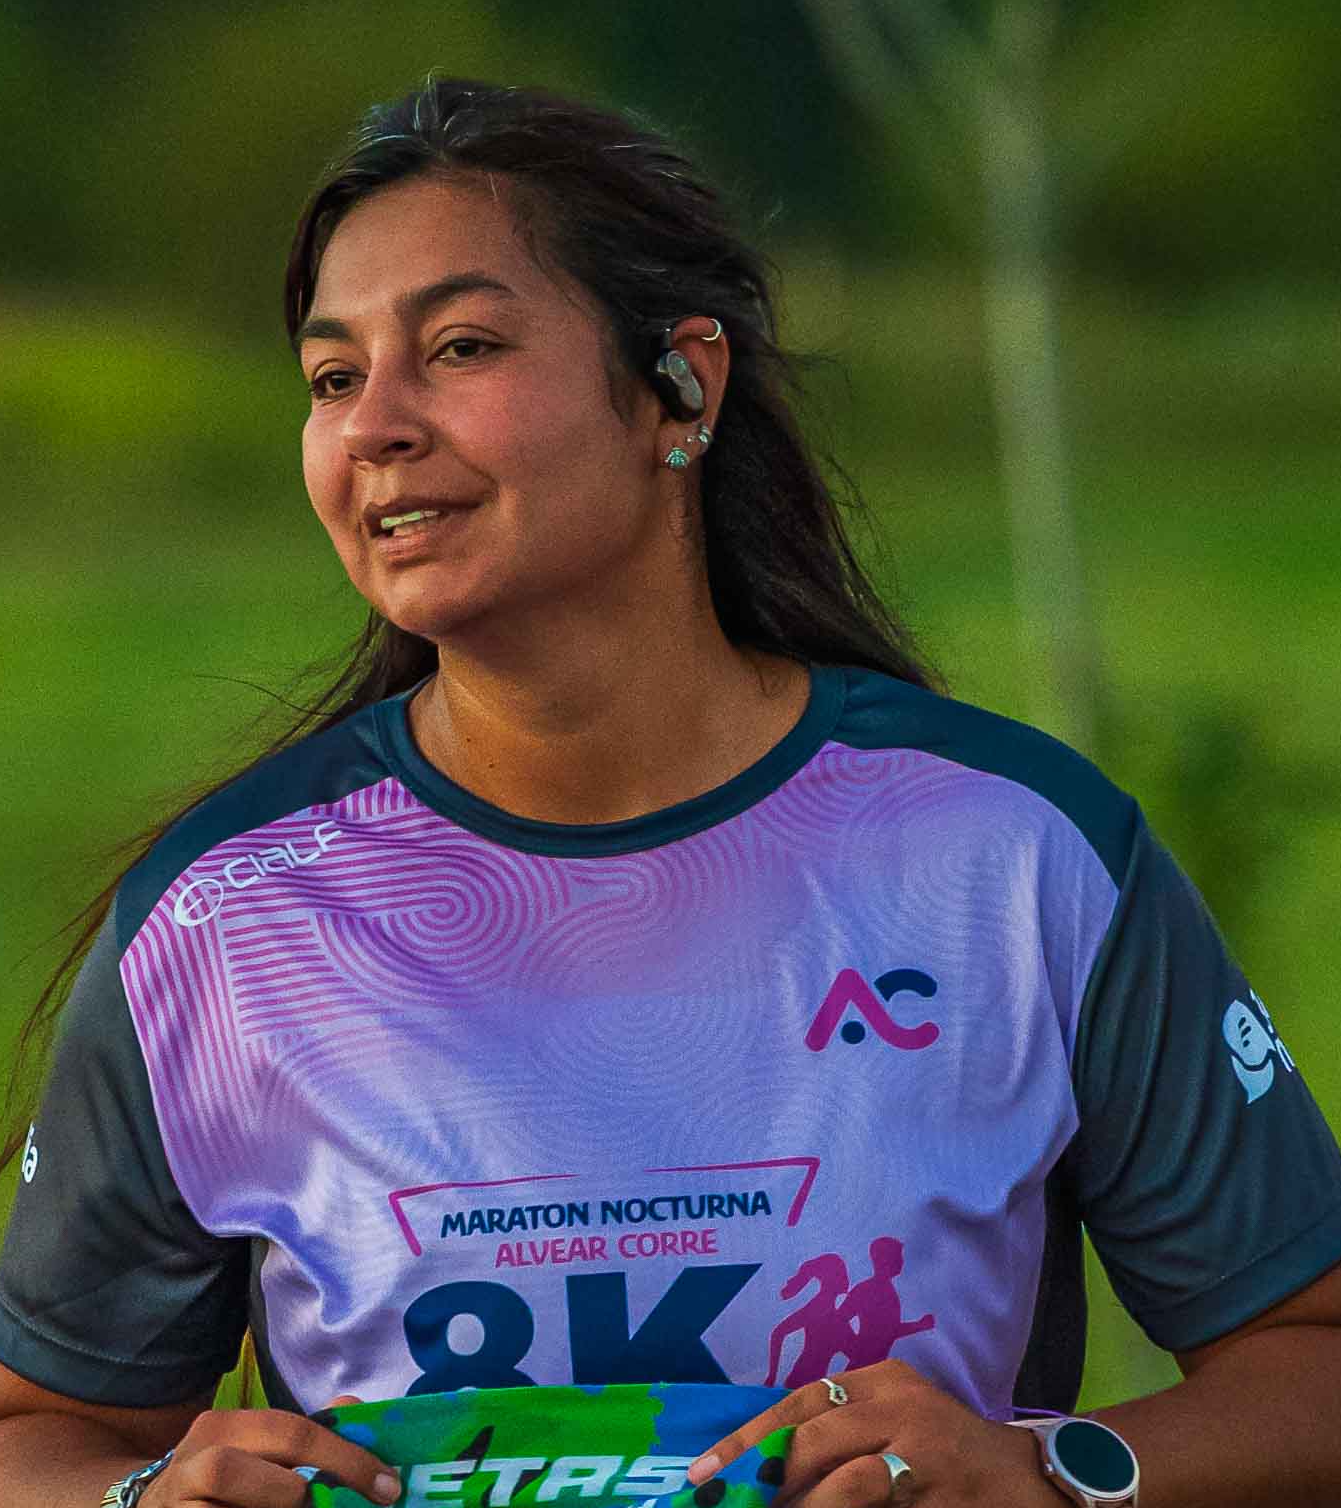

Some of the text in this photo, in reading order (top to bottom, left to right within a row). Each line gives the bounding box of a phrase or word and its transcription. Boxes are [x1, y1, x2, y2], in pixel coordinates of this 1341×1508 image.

[440, 1191, 772, 1239] MARATON NOCTURNA
[494, 1228, 720, 1269] ALVEAR CORRE
